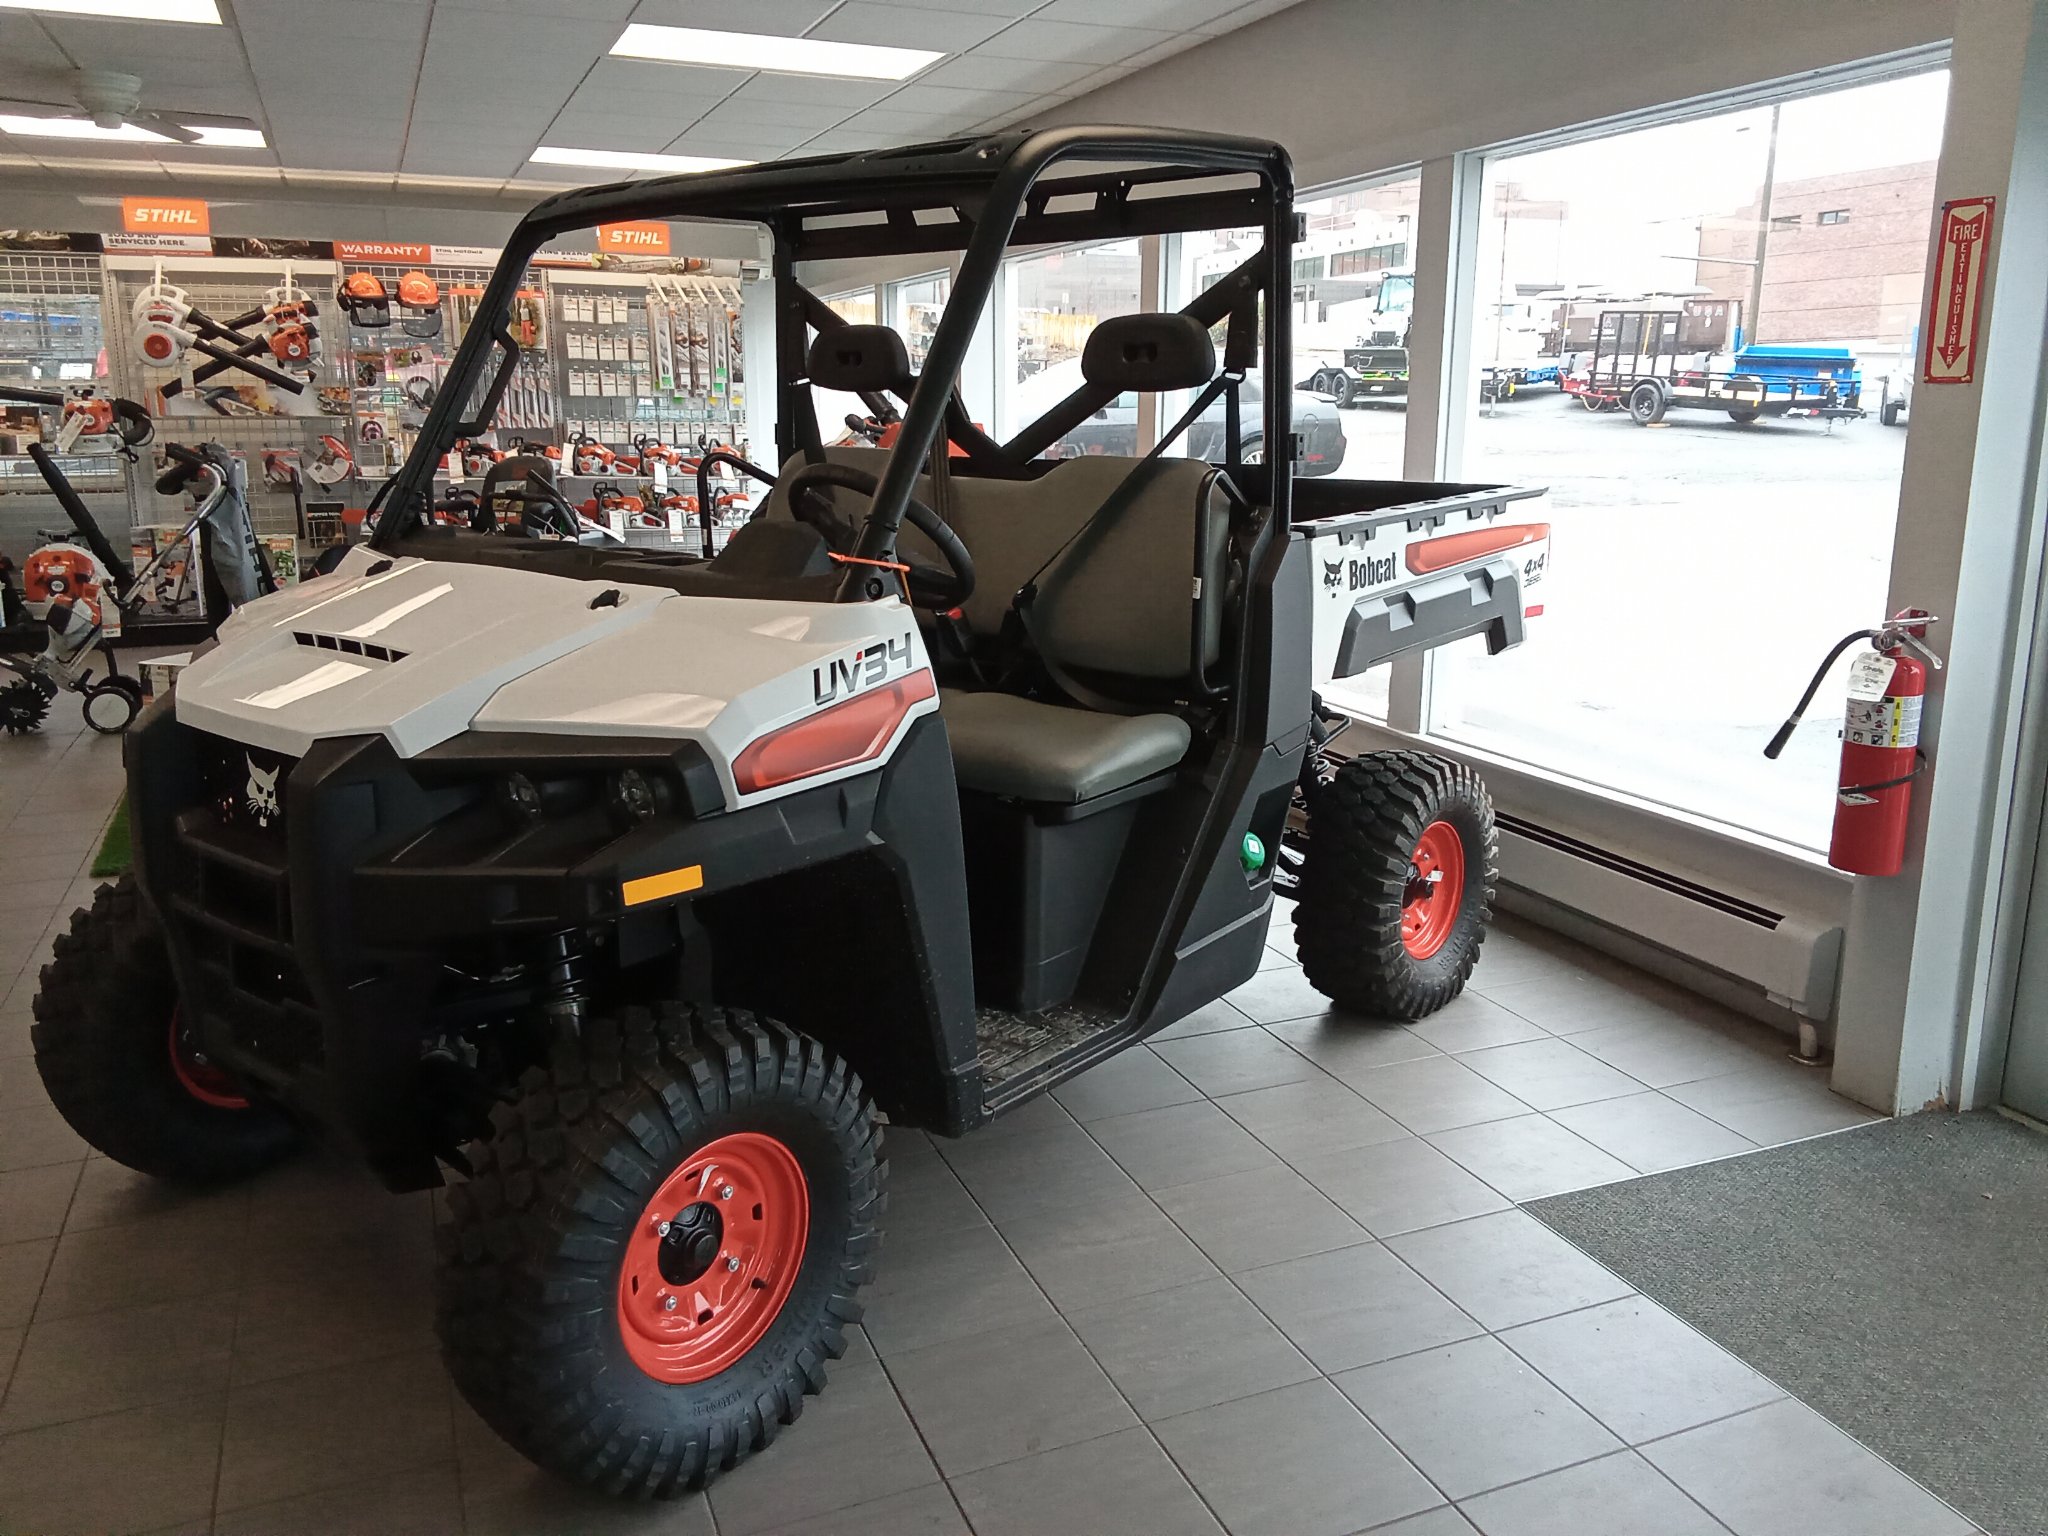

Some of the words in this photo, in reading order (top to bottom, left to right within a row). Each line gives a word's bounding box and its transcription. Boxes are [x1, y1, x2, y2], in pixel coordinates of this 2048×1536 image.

[134, 208, 198, 224] STIHL
[108, 238, 156, 246] SERVICED
[610, 230, 663, 245] STIHL
[1953, 223, 1979, 242] FIRE
[341, 244, 423, 256] WARRANTY
[1946, 242, 1968, 366] EXTINGUISHER
[1349, 552, 1397, 591] Bobcat
[1524, 553, 1545, 576] 4x4
[813, 632, 912, 706] UV34
